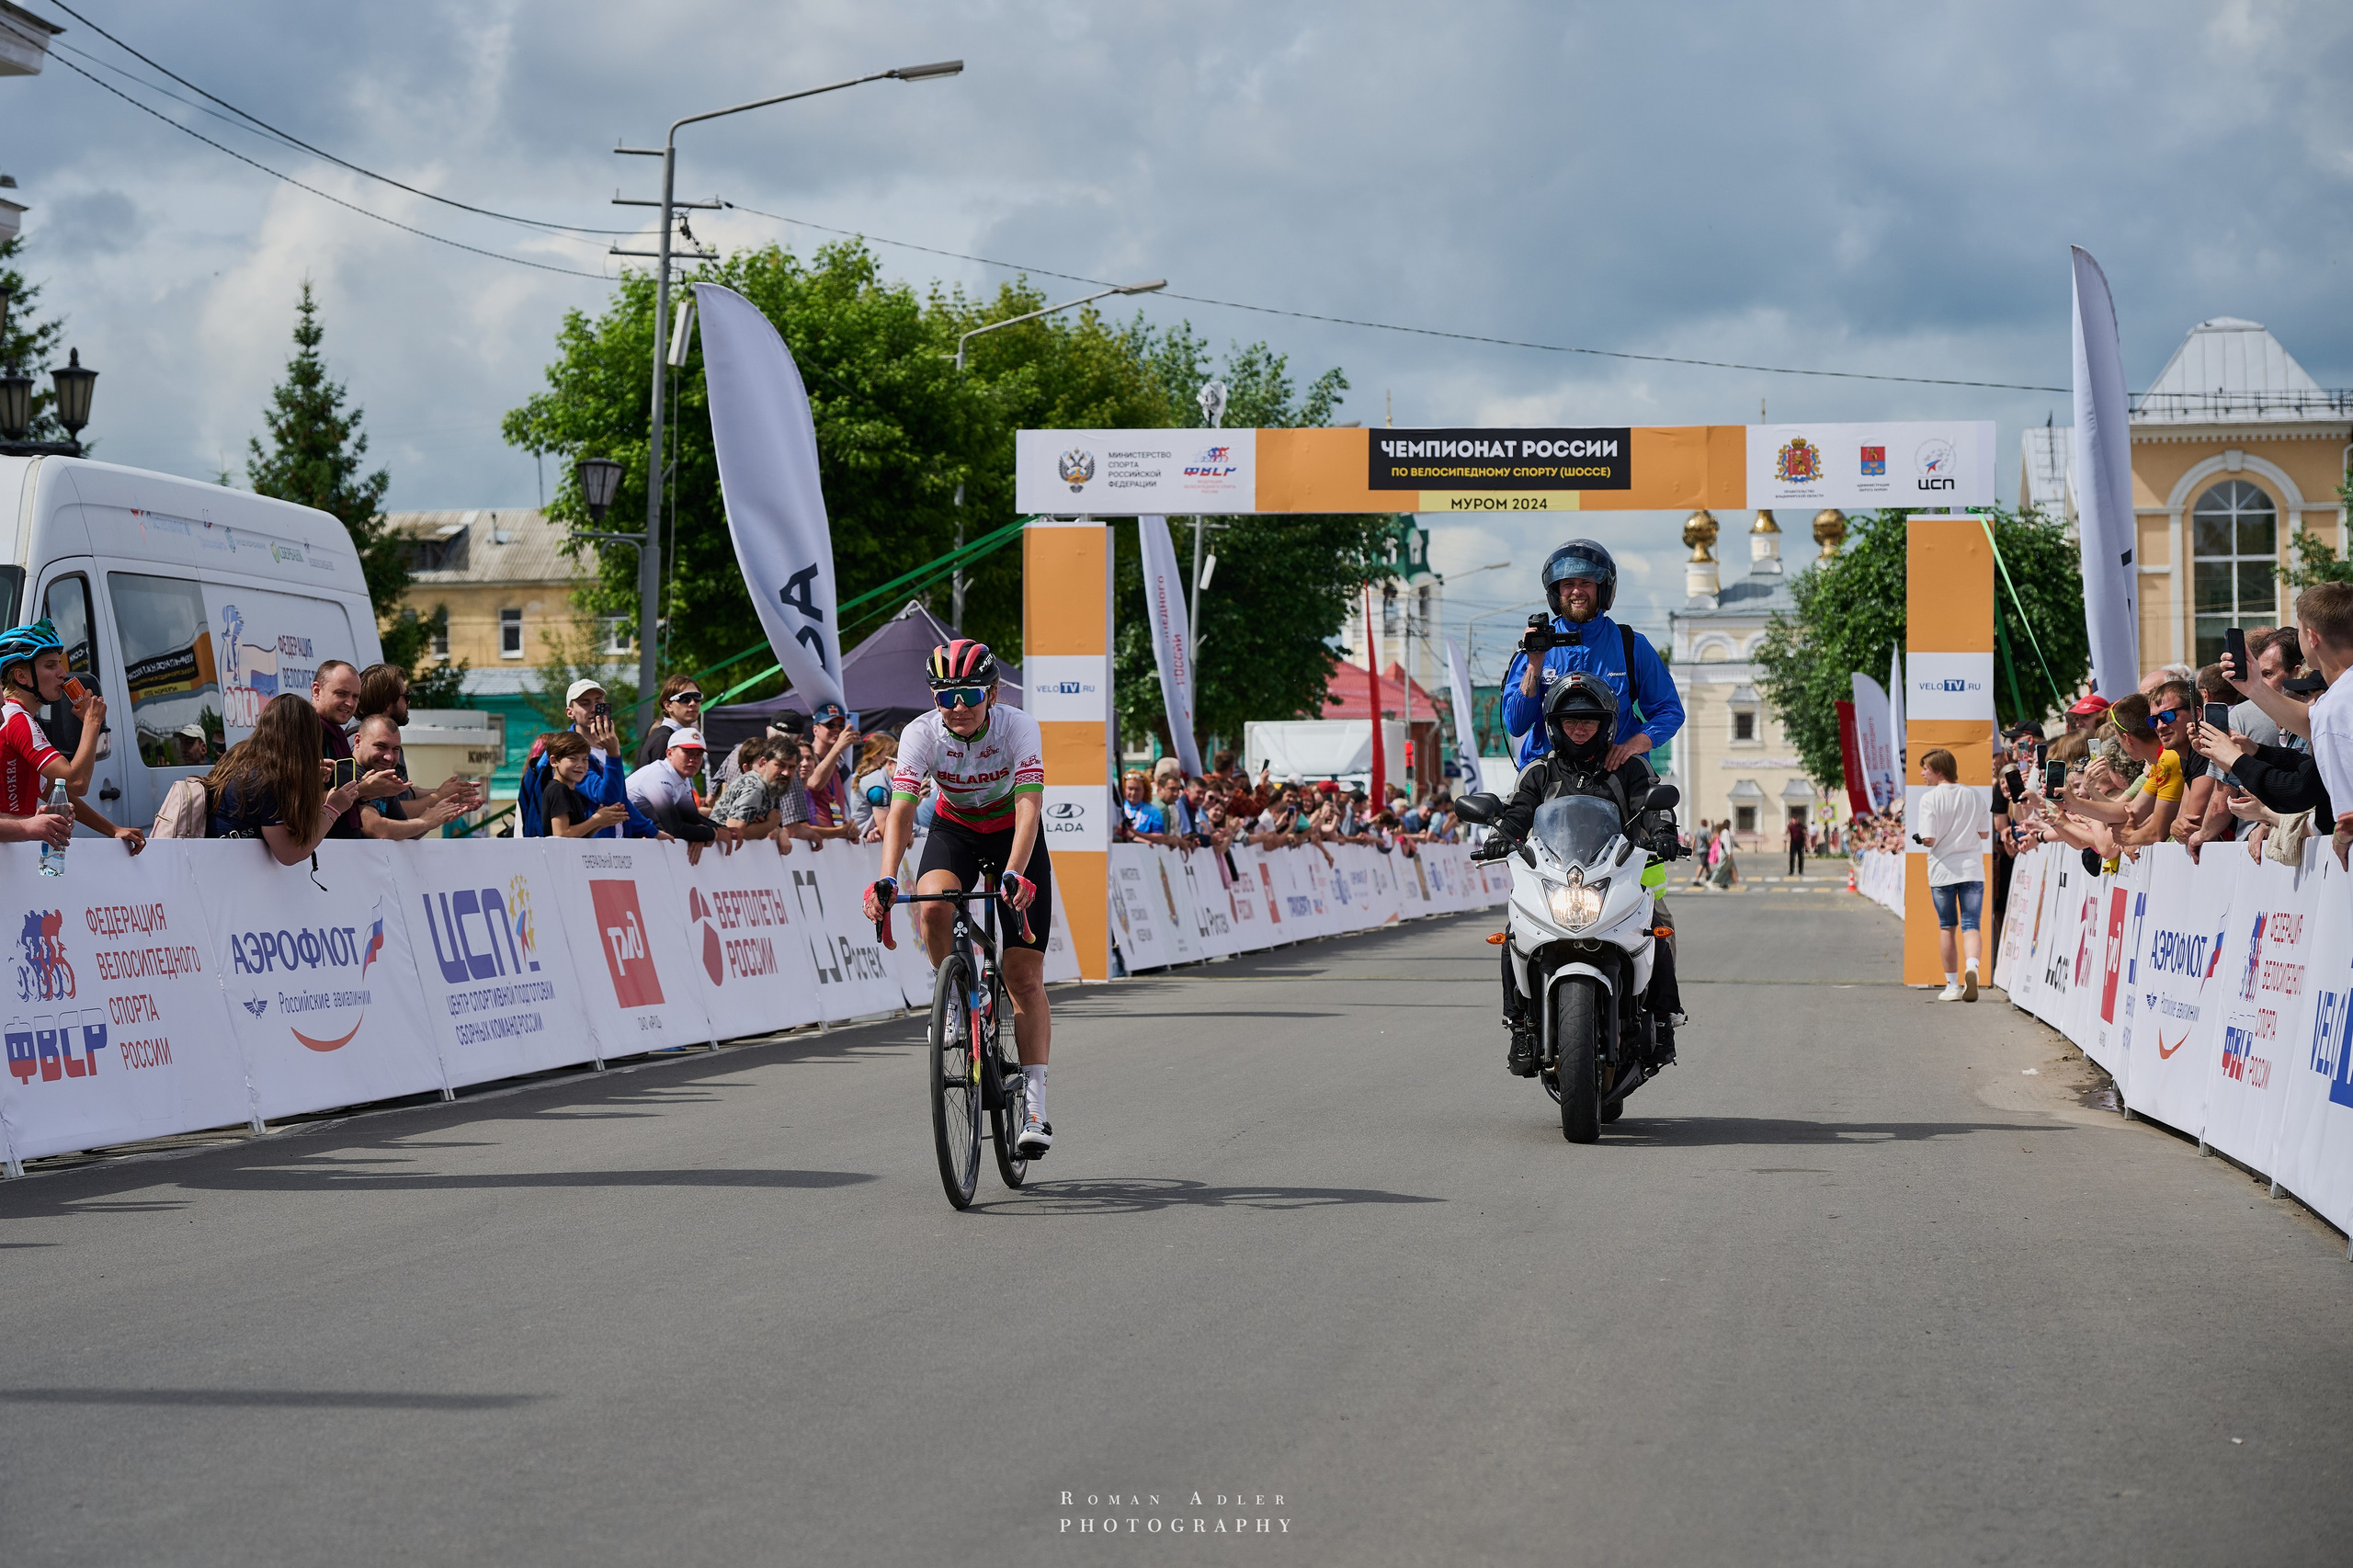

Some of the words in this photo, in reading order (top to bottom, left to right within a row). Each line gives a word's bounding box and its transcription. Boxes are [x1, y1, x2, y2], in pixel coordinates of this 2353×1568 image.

[1381, 440, 1517, 458] ЧЕМПИОНАТ
[1522, 439, 1618, 458] РОССИИ
[1108, 470, 1162, 478] РОССИЙСКОЙ
[1391, 467, 1408, 477] ПО
[1411, 467, 1510, 478] ВЕЛОСИПЕДНОМУ
[1513, 467, 1558, 477] СПОРТУ
[1560, 466, 1611, 478] (ШОССЕ)
[1918, 479, 1955, 490] ЦСП
[1451, 498, 1507, 510] МУРОМ
[1512, 498, 1548, 509] 2024
[278, 634, 313, 661] ФЕДЕРАЦИЯ
[6, 758, 19, 812] МОСКВА
[938, 767, 1010, 784] BELARUS
[1046, 824, 1085, 832] LADA
[85, 903, 167, 940] ФЕДЕРАЦИЯ
[712, 889, 789, 929] ВЕРТОЛЕТЫ
[422, 888, 522, 984] ЦСП
[2269, 912, 2303, 950] ФЕДЕРАЦИЯ
[96, 946, 201, 981] ВЕЛОСИПЕДНОГО
[232, 926, 358, 974] АЭРОФЛОТ
[725, 937, 779, 979] РОССИИ
[838, 937, 887, 981] Ростех
[2149, 929, 2208, 978] АЭРОФЛОТ
[108, 994, 160, 1025] СПОРТА
[278, 989, 331, 1014] Российские
[333, 990, 372, 1007] авиалинии
[446, 993, 470, 1019] ЦЕНТР
[469, 983, 517, 1012] СПОРТИВНОЙ
[515, 981, 555, 1007] ПОДГОТОВКИ
[455, 1020, 492, 1046] СБОРНЫХ
[489, 1015, 521, 1040] КОМАНД
[519, 1012, 544, 1033] РОССИИ
[2255, 1008, 2278, 1041] СПОРТА
[5, 1008, 108, 1085] ФВСР
[119, 1037, 173, 1070] РОССИИ
[2247, 1055, 2272, 1090] РОССИИ
